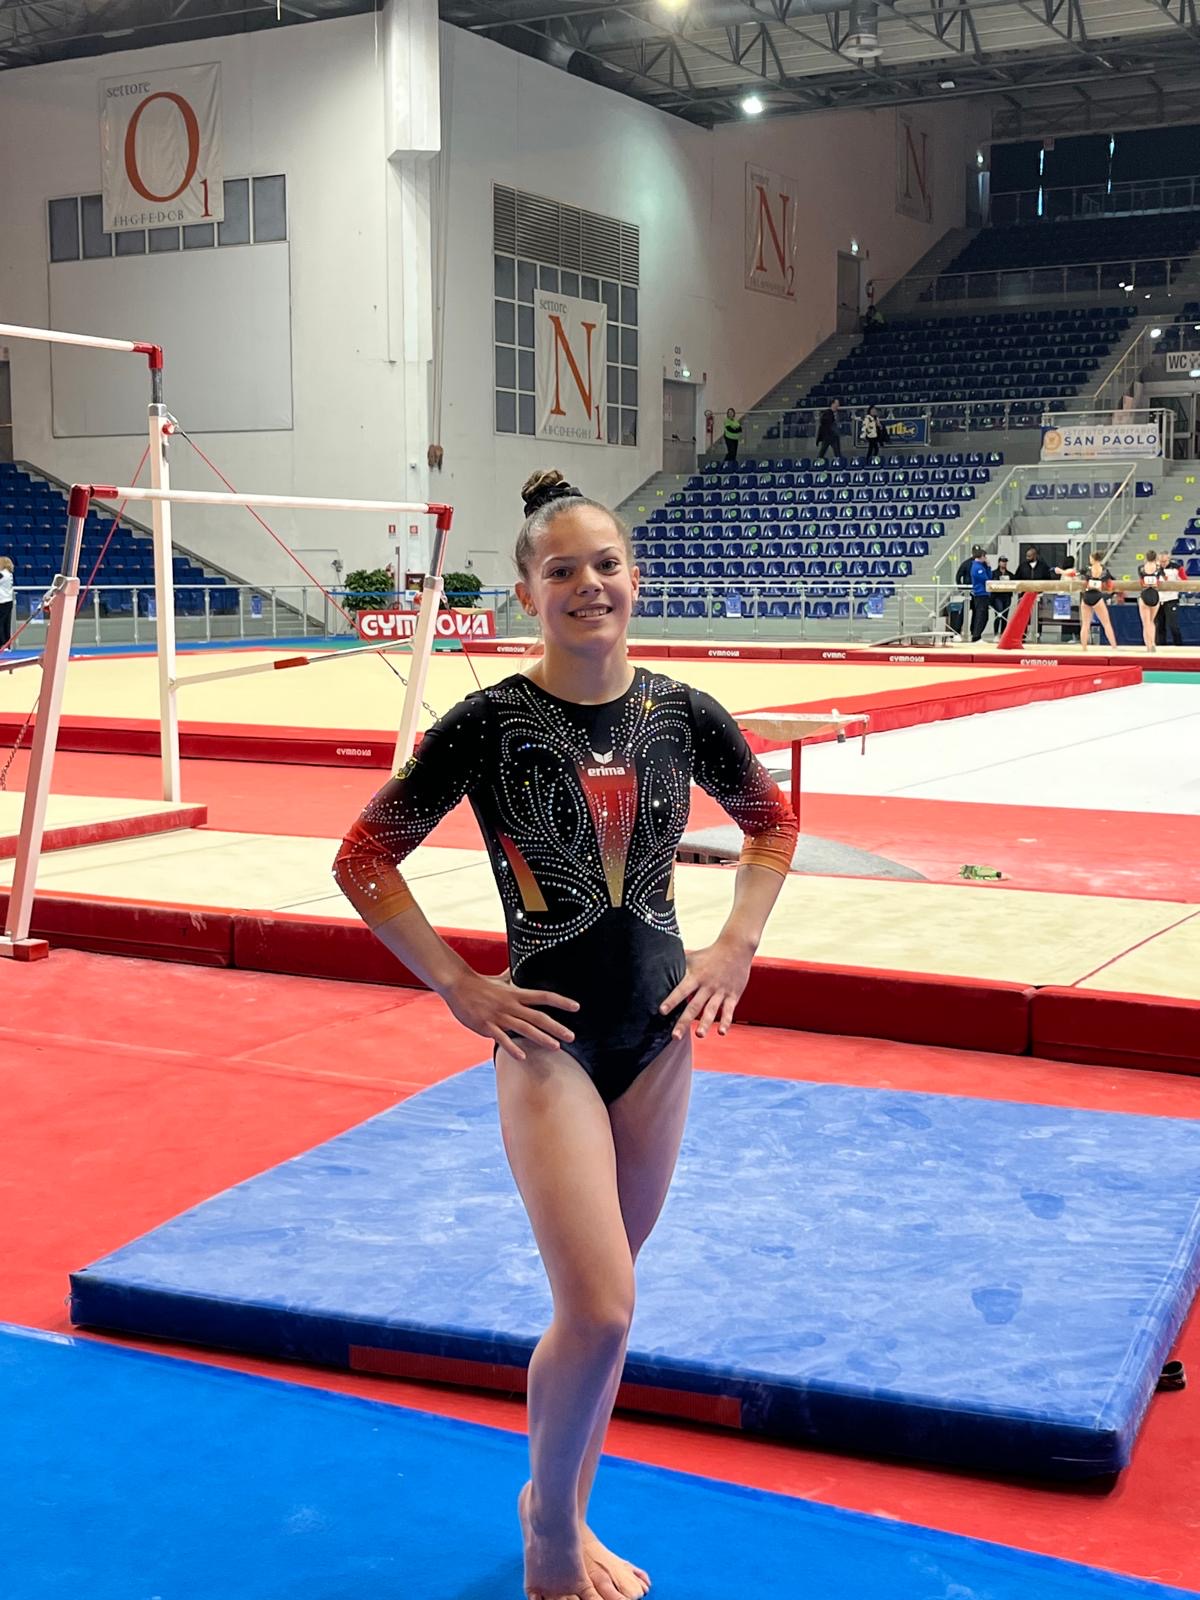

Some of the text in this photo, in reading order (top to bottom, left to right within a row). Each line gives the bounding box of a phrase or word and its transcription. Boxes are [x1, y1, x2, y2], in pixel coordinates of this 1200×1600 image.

[107, 82, 150, 98] settore
[756, 185, 790, 279] N
[786, 265, 795, 297] 2
[539, 299, 568, 314] settore
[548, 314, 597, 421] N
[1168, 354, 1187, 369] WC
[1064, 434, 1157, 447] SAN PAOLO
[361, 614, 489, 637] GYMOVA
[587, 765, 626, 777] erima
